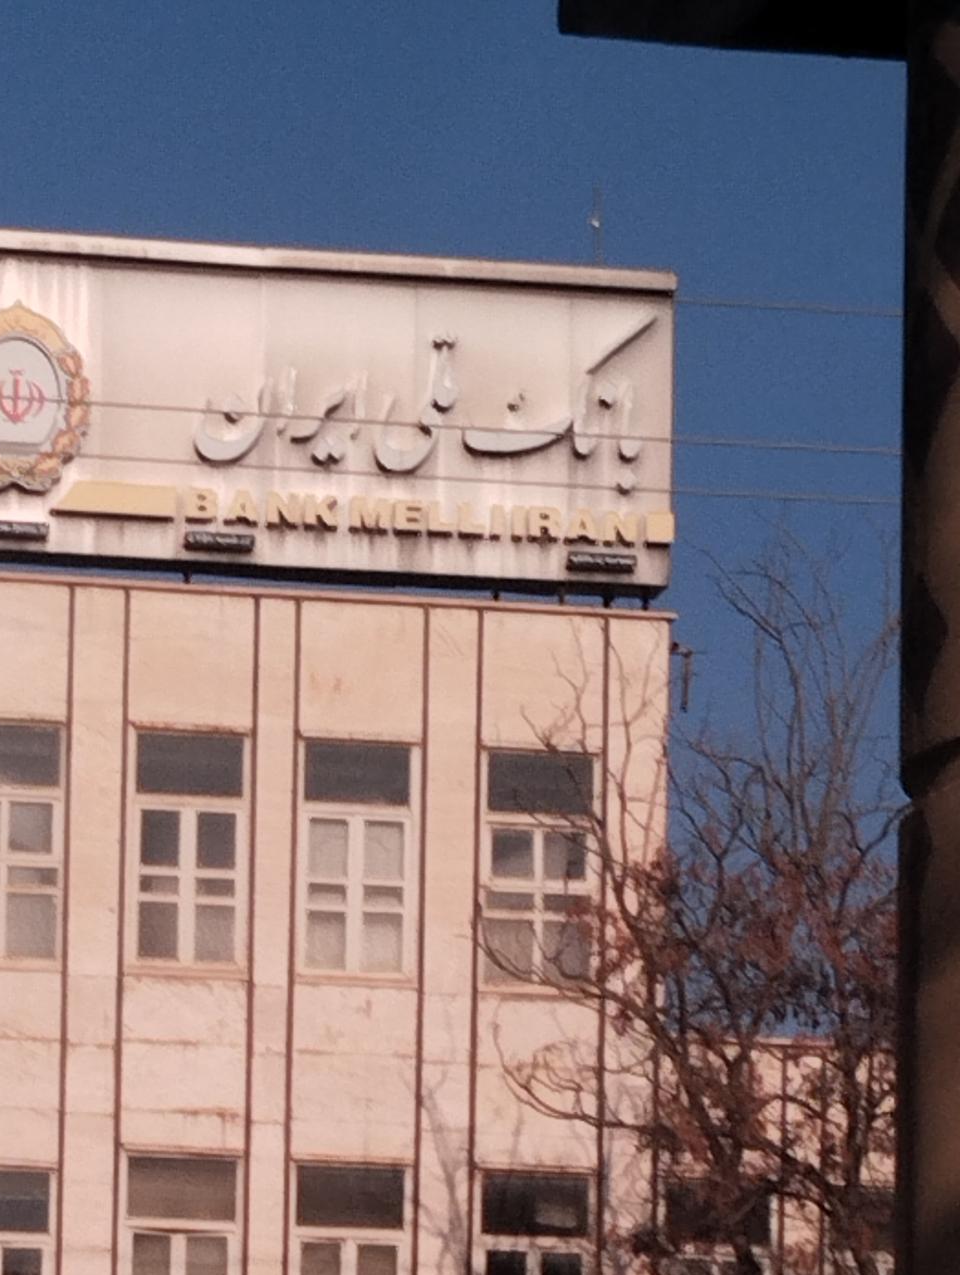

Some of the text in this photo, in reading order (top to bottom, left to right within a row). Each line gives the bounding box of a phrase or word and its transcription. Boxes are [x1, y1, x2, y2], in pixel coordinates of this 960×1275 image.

[192, 364, 370, 468] ایران
[460, 312, 659, 496] بانک
[185, 486, 638, 548] BANK MELLI IRAN
